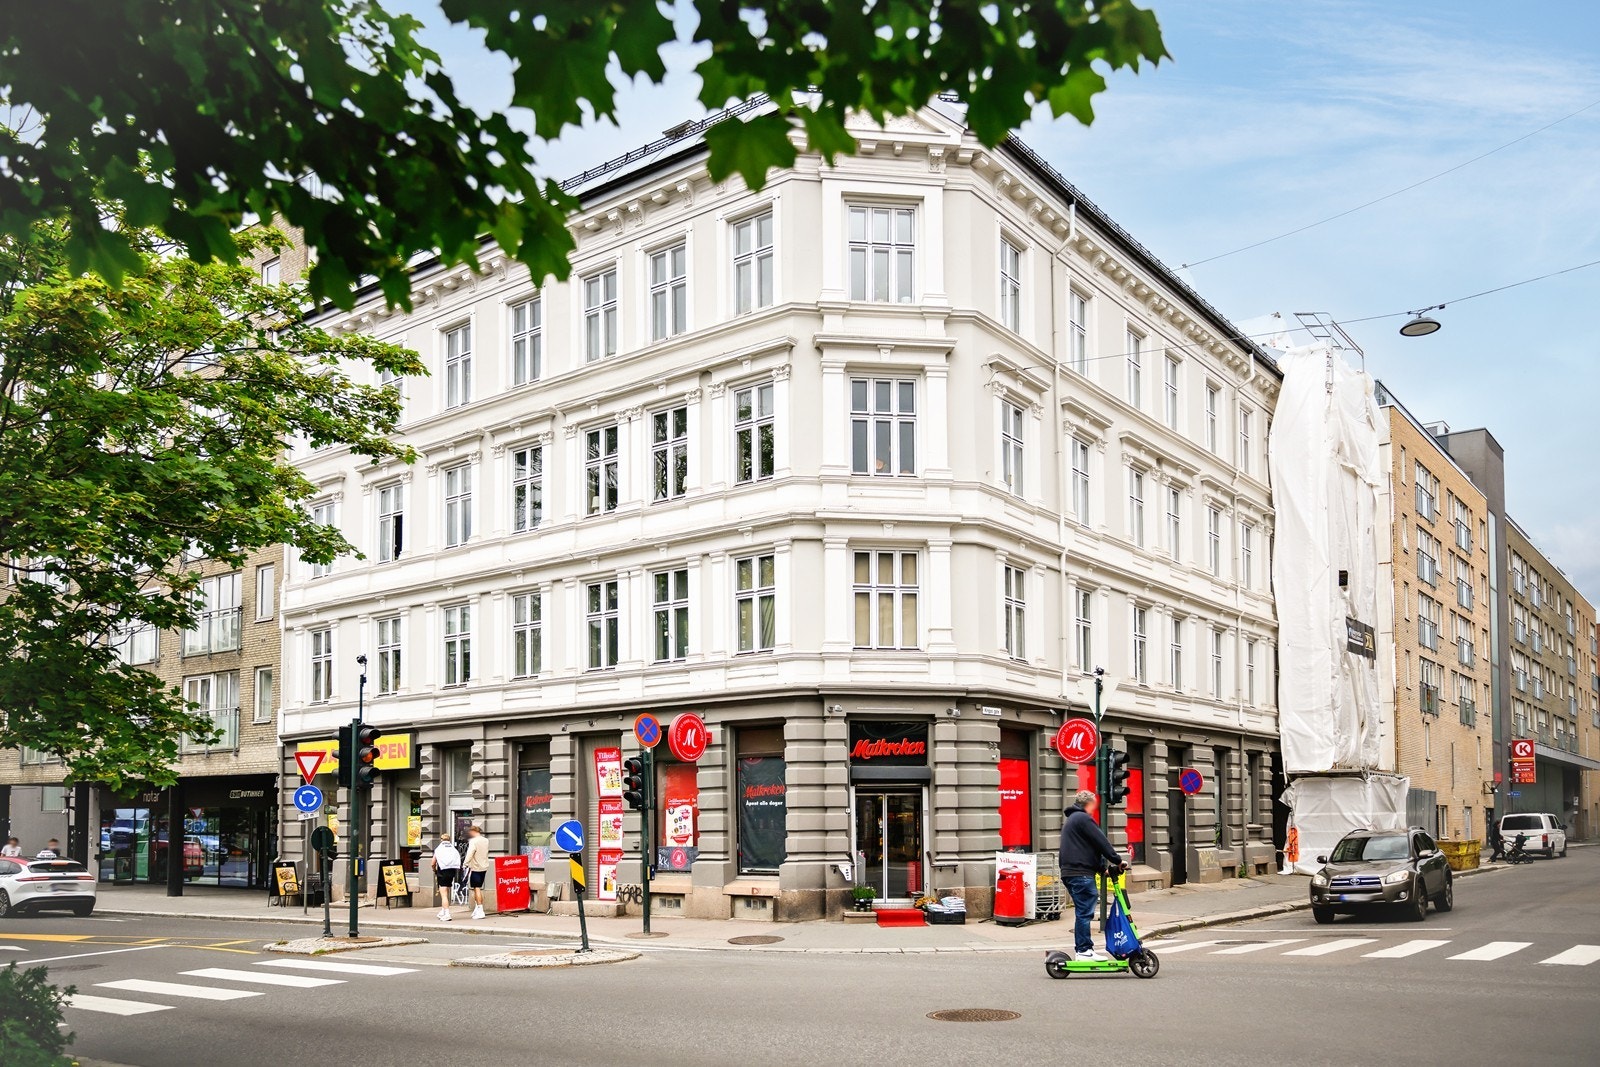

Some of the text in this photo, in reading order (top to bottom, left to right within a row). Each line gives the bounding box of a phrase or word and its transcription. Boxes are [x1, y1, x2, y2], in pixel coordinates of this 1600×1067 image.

[683, 728, 698, 748] M
[1066, 732, 1085, 751] M
[849, 738, 925, 759] Matkroken
[1000, 858, 1032, 866] Velkommen!
[499, 877, 528, 885] Døgnåpent
